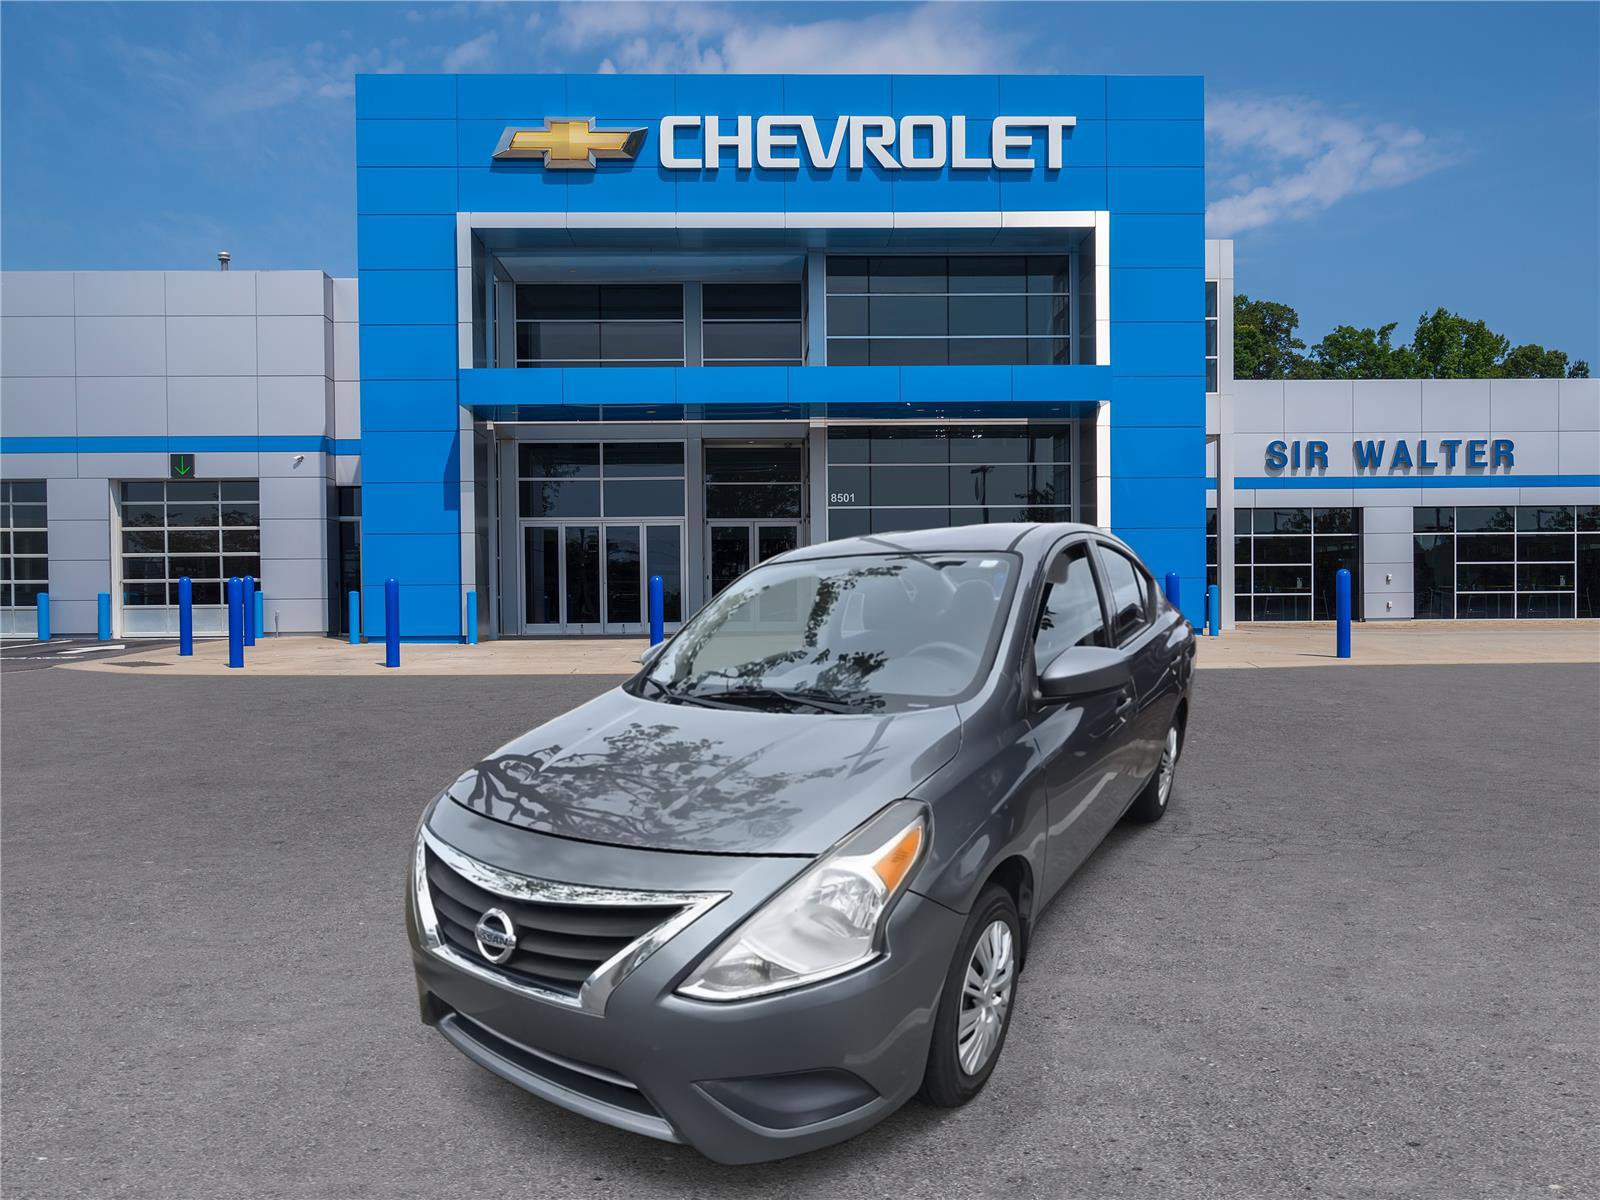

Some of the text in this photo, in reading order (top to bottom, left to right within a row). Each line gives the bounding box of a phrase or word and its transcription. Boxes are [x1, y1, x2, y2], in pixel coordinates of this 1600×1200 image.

[659, 115, 1077, 169] CHEVROLET
[1265, 439, 1516, 470] SIR WALTER
[830, 493, 855, 503] 8501
